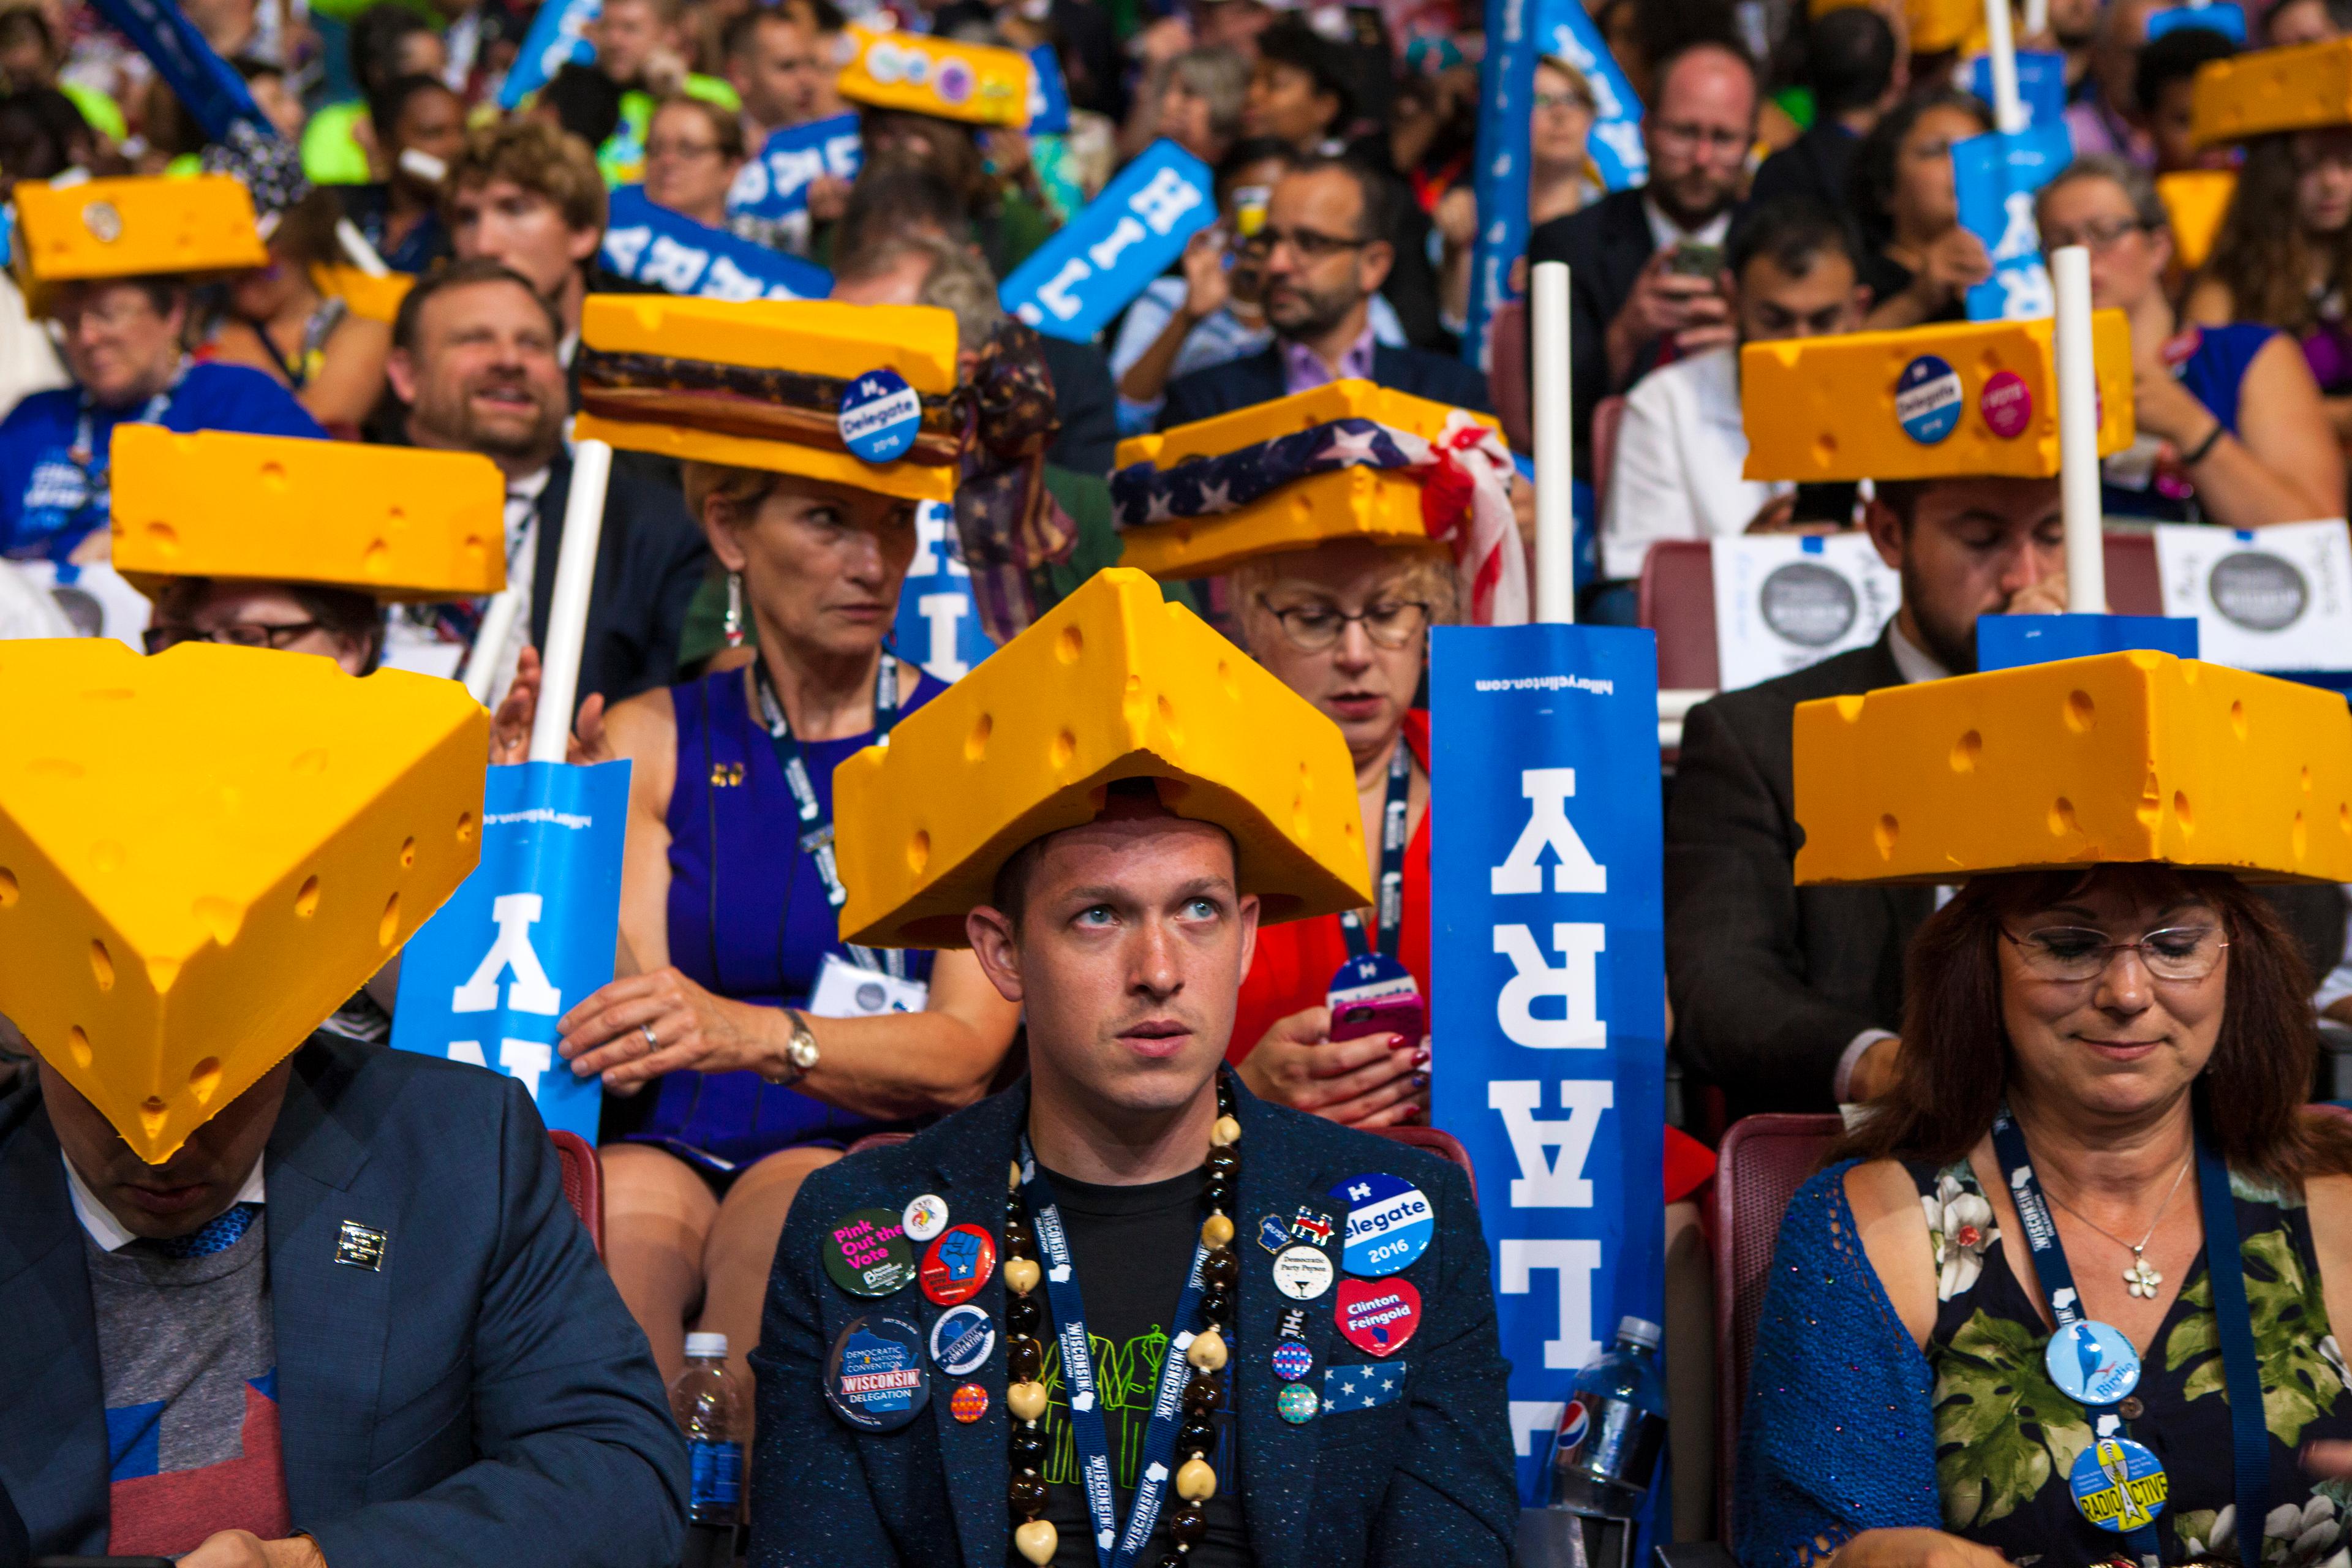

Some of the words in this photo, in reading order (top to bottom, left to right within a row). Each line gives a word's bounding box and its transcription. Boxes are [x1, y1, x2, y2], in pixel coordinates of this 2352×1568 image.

[1475, 673, 1613, 696] hillaryclinton.com
[833, 1219, 875, 1244] Pink
[1345, 1201, 1425, 1239] elegate
[2015, 1188, 2049, 1250] WISCONSIN
[841, 1235, 877, 1256] Out
[875, 1224, 903, 1242] the
[1041, 1205, 1068, 1263] WISCONSIN
[845, 1248, 889, 1269] Vote
[1368, 1238, 1409, 1263] 2016
[1281, 1264, 1300, 1273] Party
[1348, 1294, 1400, 1315] Clinton
[1348, 1305, 1411, 1332] Feingold
[846, 1347, 902, 1359] DEMOCRATIC
[1068, 1324, 1091, 1389] WISCONSIN
[847, 1361, 903, 1373] CONVENTION
[2096, 1363, 2133, 1397] Birdie
[843, 1371, 917, 1392] WISCONSIN
[1158, 1351, 1186, 1418] WISCONSIN
[850, 1389, 912, 1404] DELEGATION
[1092, 1457, 1114, 1528] WISCONSIN
[1125, 1482, 1156, 1552] WISCONSIN
